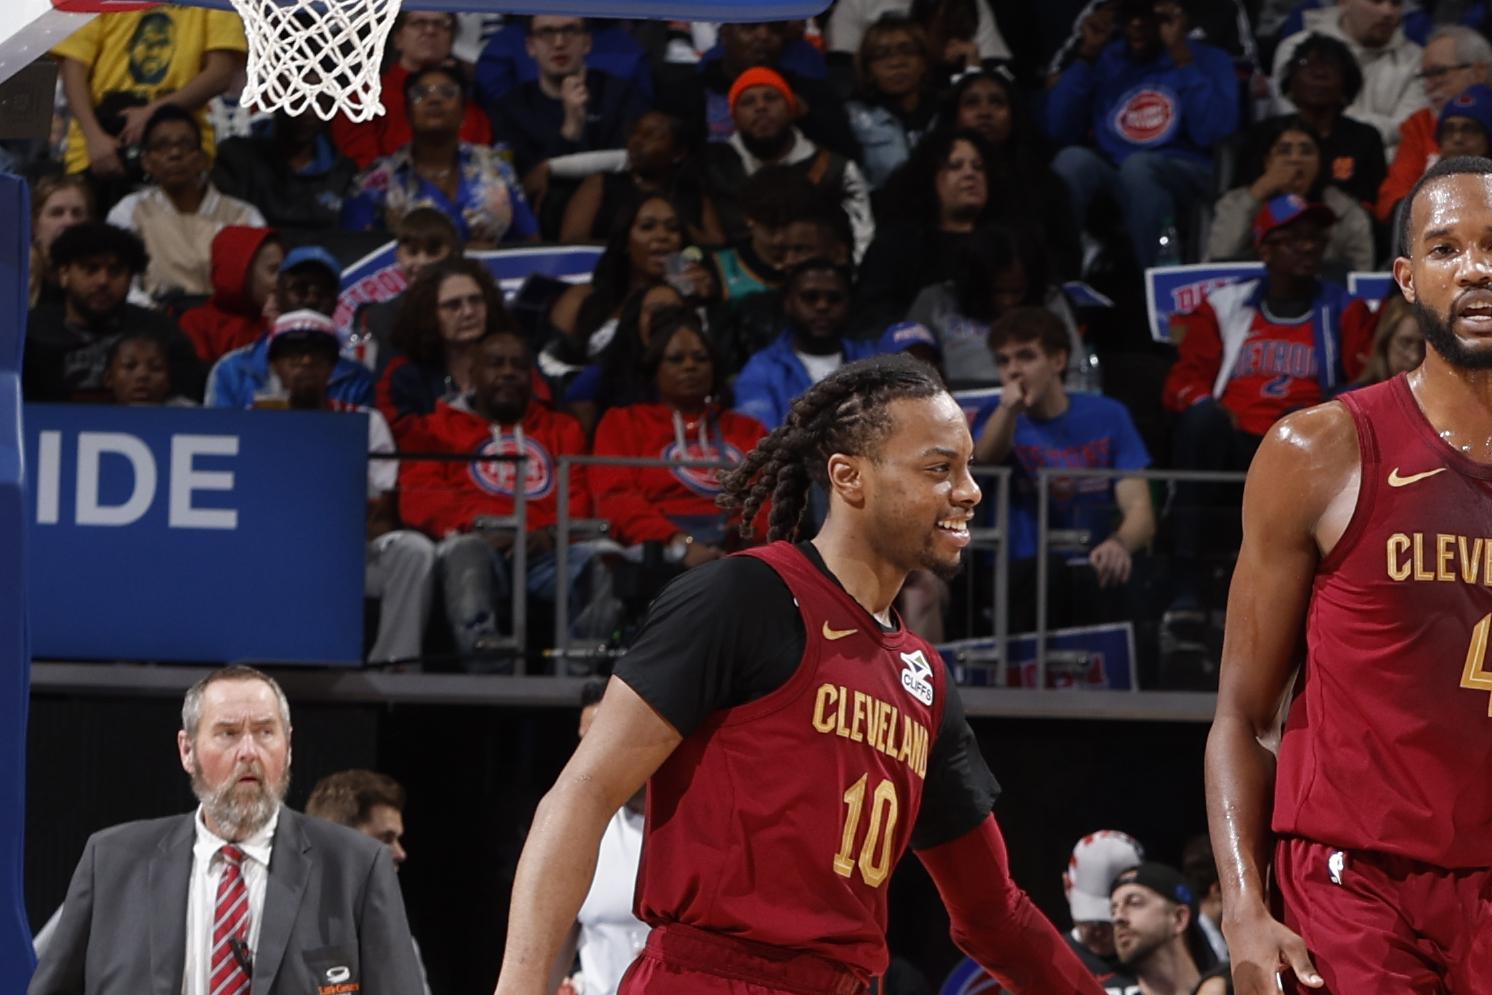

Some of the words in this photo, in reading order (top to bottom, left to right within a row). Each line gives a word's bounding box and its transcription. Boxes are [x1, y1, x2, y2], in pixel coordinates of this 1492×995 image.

[1260, 373, 1293, 398] 2
[36, 430, 240, 530] IDE
[812, 683, 930, 780] CLEVELAND
[904, 673, 933, 702] CLIFFS
[832, 772, 899, 888] 10
